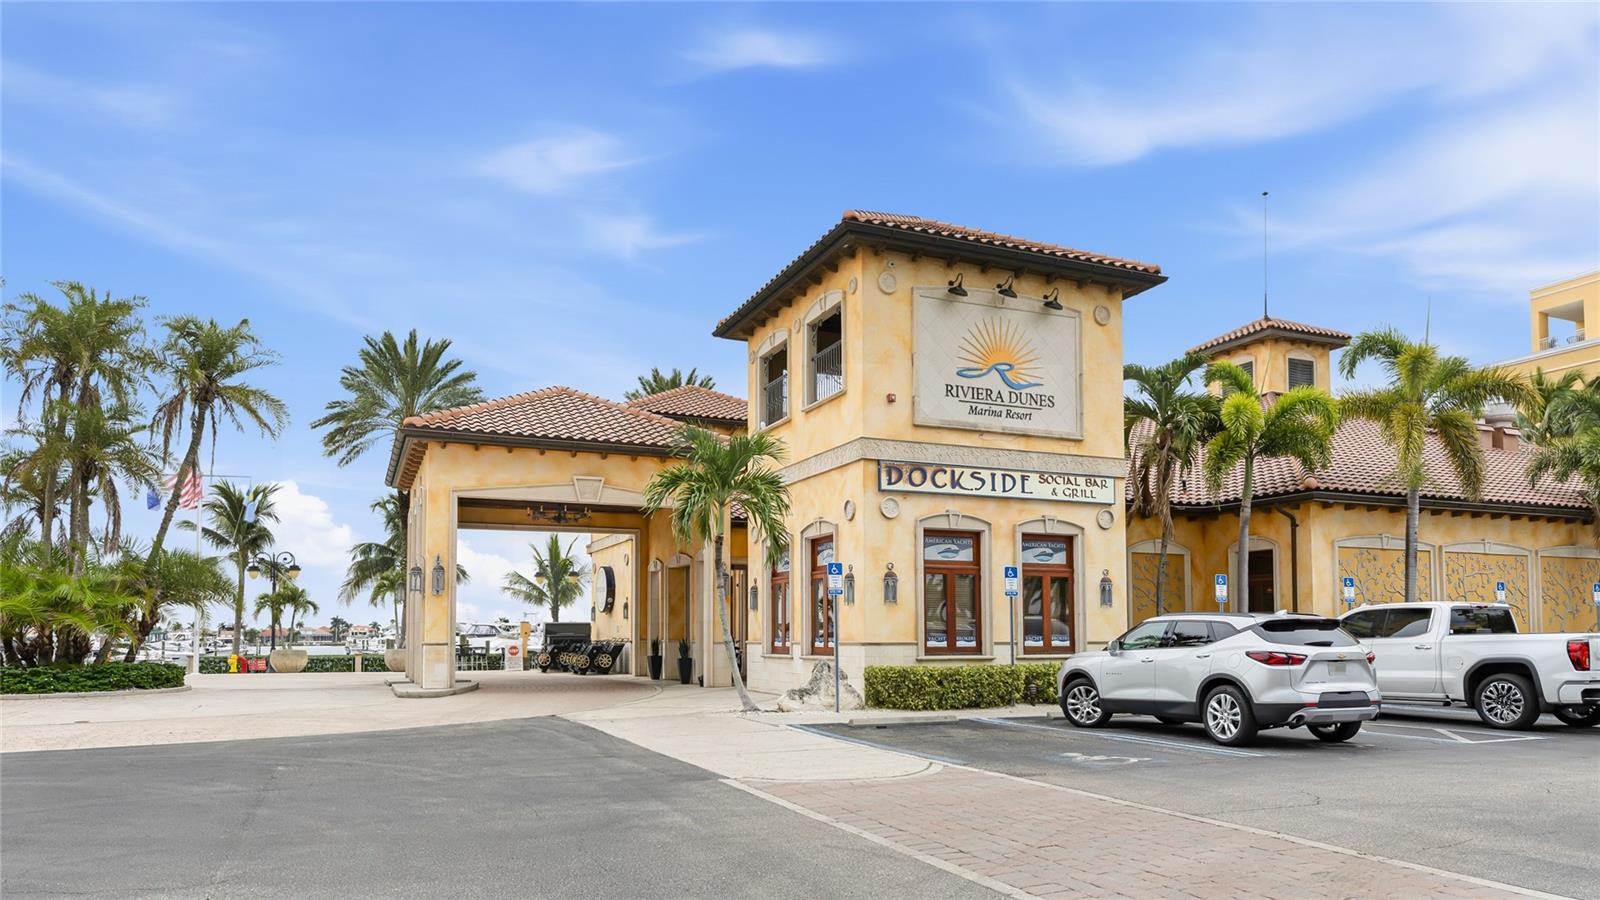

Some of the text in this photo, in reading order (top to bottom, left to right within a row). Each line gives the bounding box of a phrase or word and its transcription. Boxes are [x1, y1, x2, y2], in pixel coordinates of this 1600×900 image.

[945, 384, 1055, 408] RIVIERA DUNES
[968, 405, 1032, 420] Marina Resort
[885, 465, 1033, 494] DOCKSIDE
[1038, 473, 1108, 489] SOCIAL BAR
[1051, 488, 1097, 499] & GRILL
